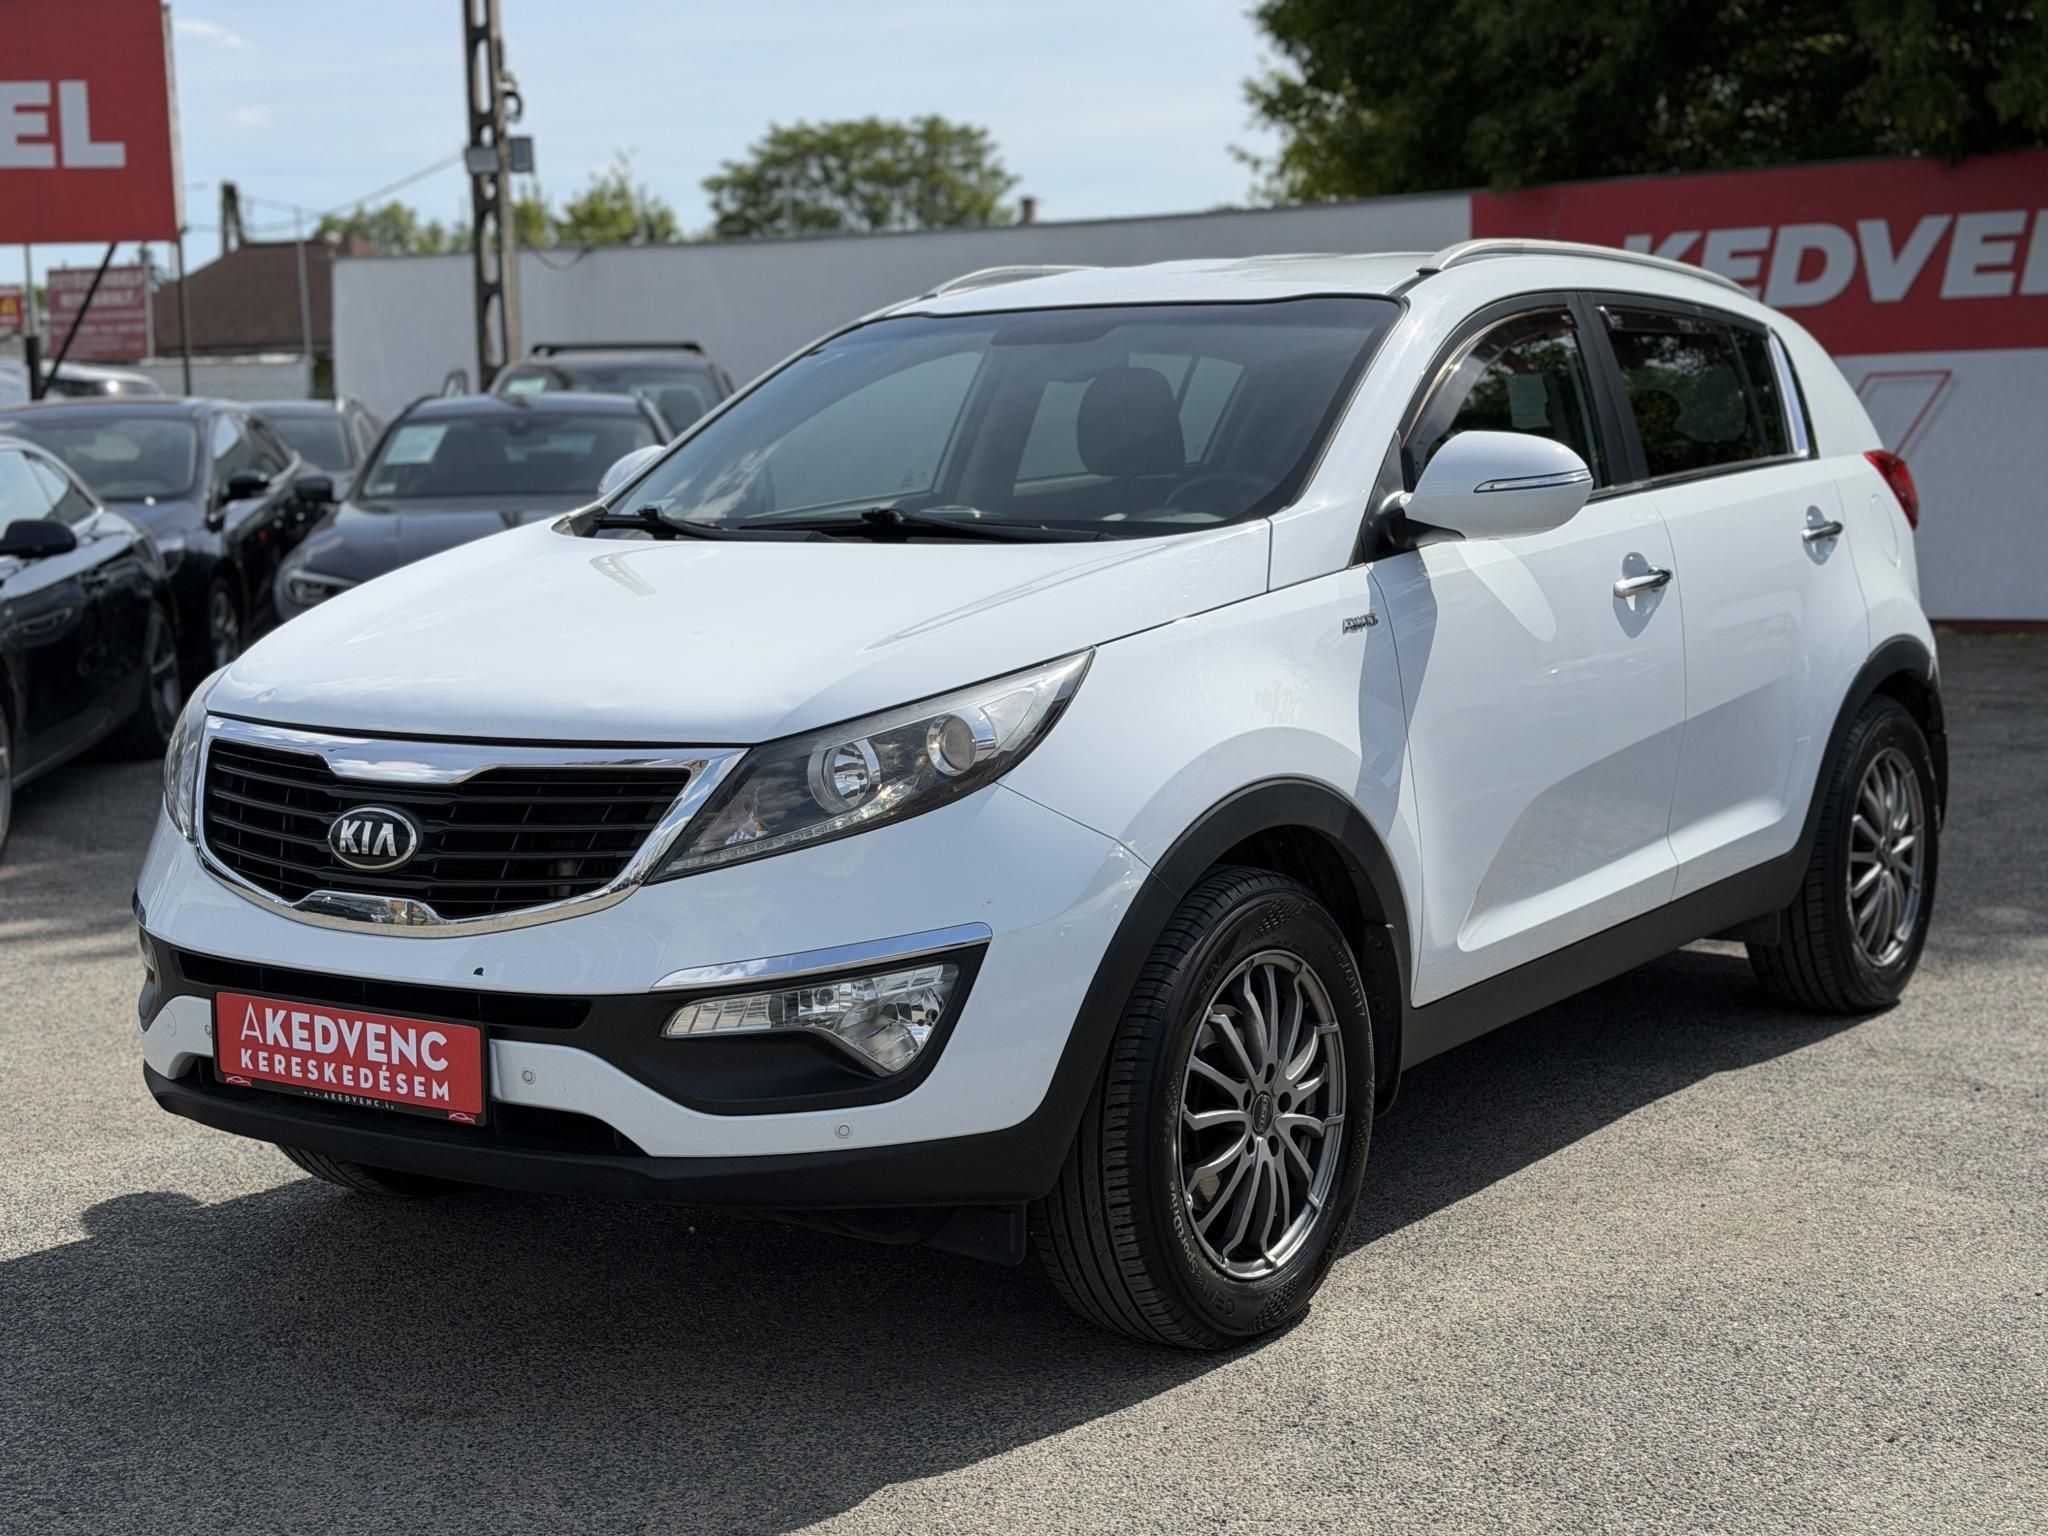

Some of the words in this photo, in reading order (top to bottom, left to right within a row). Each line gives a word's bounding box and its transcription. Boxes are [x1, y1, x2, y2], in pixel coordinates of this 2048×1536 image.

[339, 820, 397, 857] KIA
[240, 1047, 450, 1102] KERESKEDÉSEM
[1169, 1181, 1199, 1274] SportDrive
